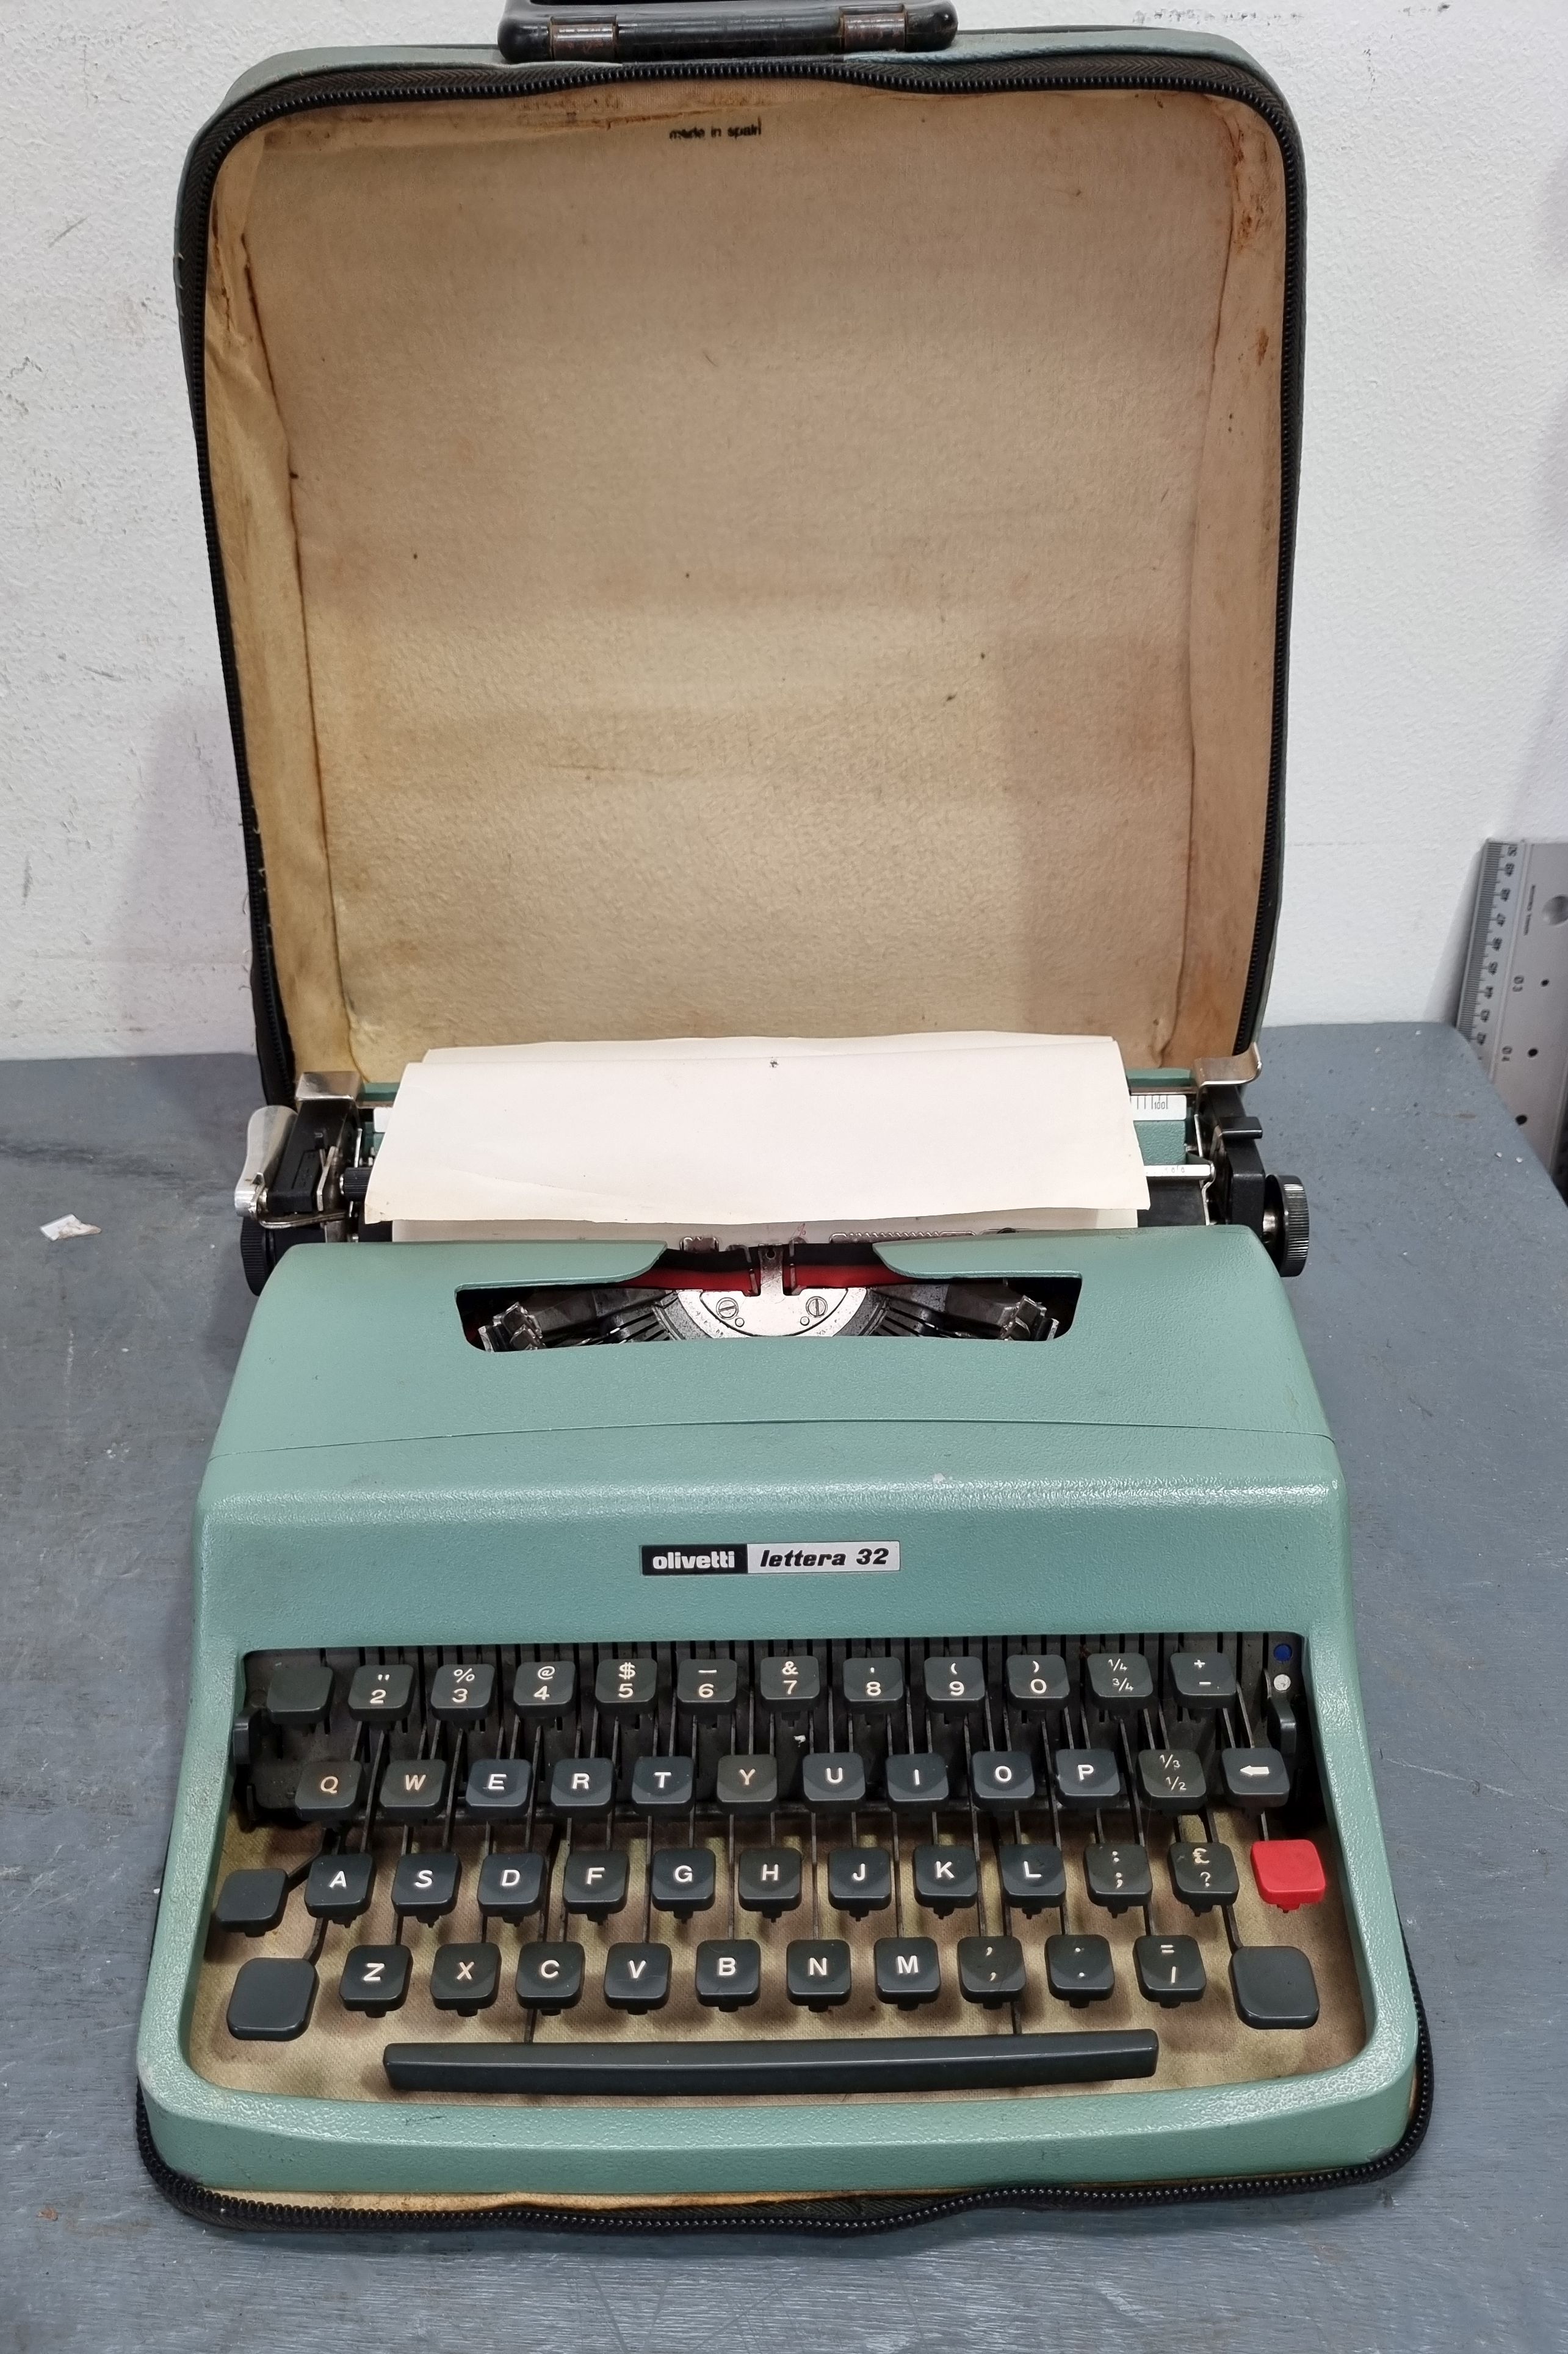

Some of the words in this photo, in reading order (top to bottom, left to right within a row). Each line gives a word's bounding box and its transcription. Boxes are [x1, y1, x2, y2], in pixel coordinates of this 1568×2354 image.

[710, 126, 721, 137] in
[1154, 1101, 1165, 1110] 100
[652, 1551, 735, 1570] olivetti
[760, 1549, 846, 1567] lettera
[856, 1548, 889, 1565] 32
[537, 1665, 555, 1681] @
[618, 1662, 636, 1680] $
[782, 1660, 799, 1675] &
[950, 1662, 958, 1675] (
[1032, 1660, 1039, 1673] )
[453, 1668, 475, 1683] %
[452, 1688, 468, 1703] 3
[533, 1686, 550, 1701] 4
[618, 1683, 634, 1698] 5
[698, 1683, 714, 1698] 6
[783, 1679, 797, 1695] 7
[866, 1681, 881, 1697] 8
[949, 1681, 964, 1696] 9
[370, 1689, 386, 1704] 2
[572, 1773, 590, 1789] R
[654, 1772, 671, 1789] T
[739, 1769, 756, 1786] Y
[826, 1767, 843, 1784] U
[994, 1766, 1012, 1783] O
[1077, 1764, 1094, 1781] P
[320, 1776, 339, 1794] Q
[405, 1774, 426, 1791] W
[487, 1773, 507, 1791] E
[1112, 1851, 1119, 1863] :
[1192, 1847, 1210, 1864] £
[501, 1869, 521, 1887] D
[586, 1867, 605, 1885] F
[674, 1865, 693, 1883] G
[761, 1864, 779, 1881] H
[852, 1863, 865, 1881] J
[936, 1861, 955, 1878] K
[1024, 1861, 1042, 1878] L
[328, 1871, 347, 1888] A
[414, 1870, 433, 1888] S
[1115, 1872, 1123, 1889] ;
[1200, 1871, 1211, 1888] ?
[1160, 1944, 1175, 1954] =
[362, 1962, 385, 1982] Z
[457, 1961, 474, 1980] X
[541, 1960, 560, 1979] C
[629, 1959, 646, 1979] V
[718, 1957, 736, 1976] B
[809, 1957, 827, 1976] N
[897, 1955, 919, 1974] M
